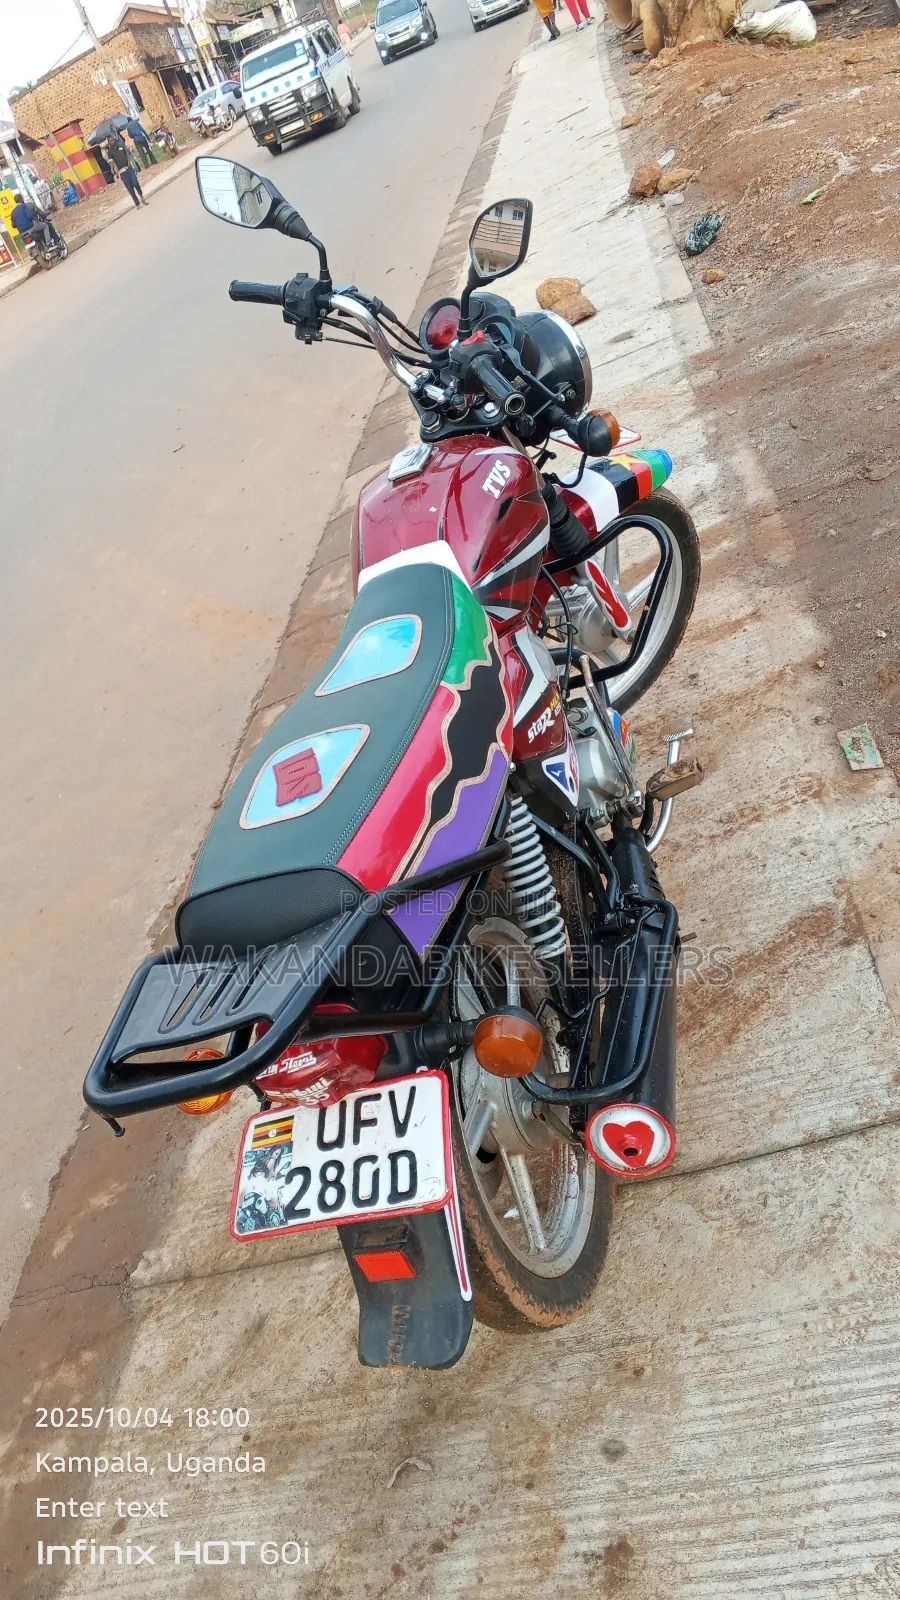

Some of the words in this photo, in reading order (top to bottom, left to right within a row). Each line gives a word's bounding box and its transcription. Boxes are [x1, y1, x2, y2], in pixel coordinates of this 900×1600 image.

[482, 459, 511, 499] TVS
[316, 1085, 416, 1152] UFV
[284, 1149, 418, 1220] 280D
